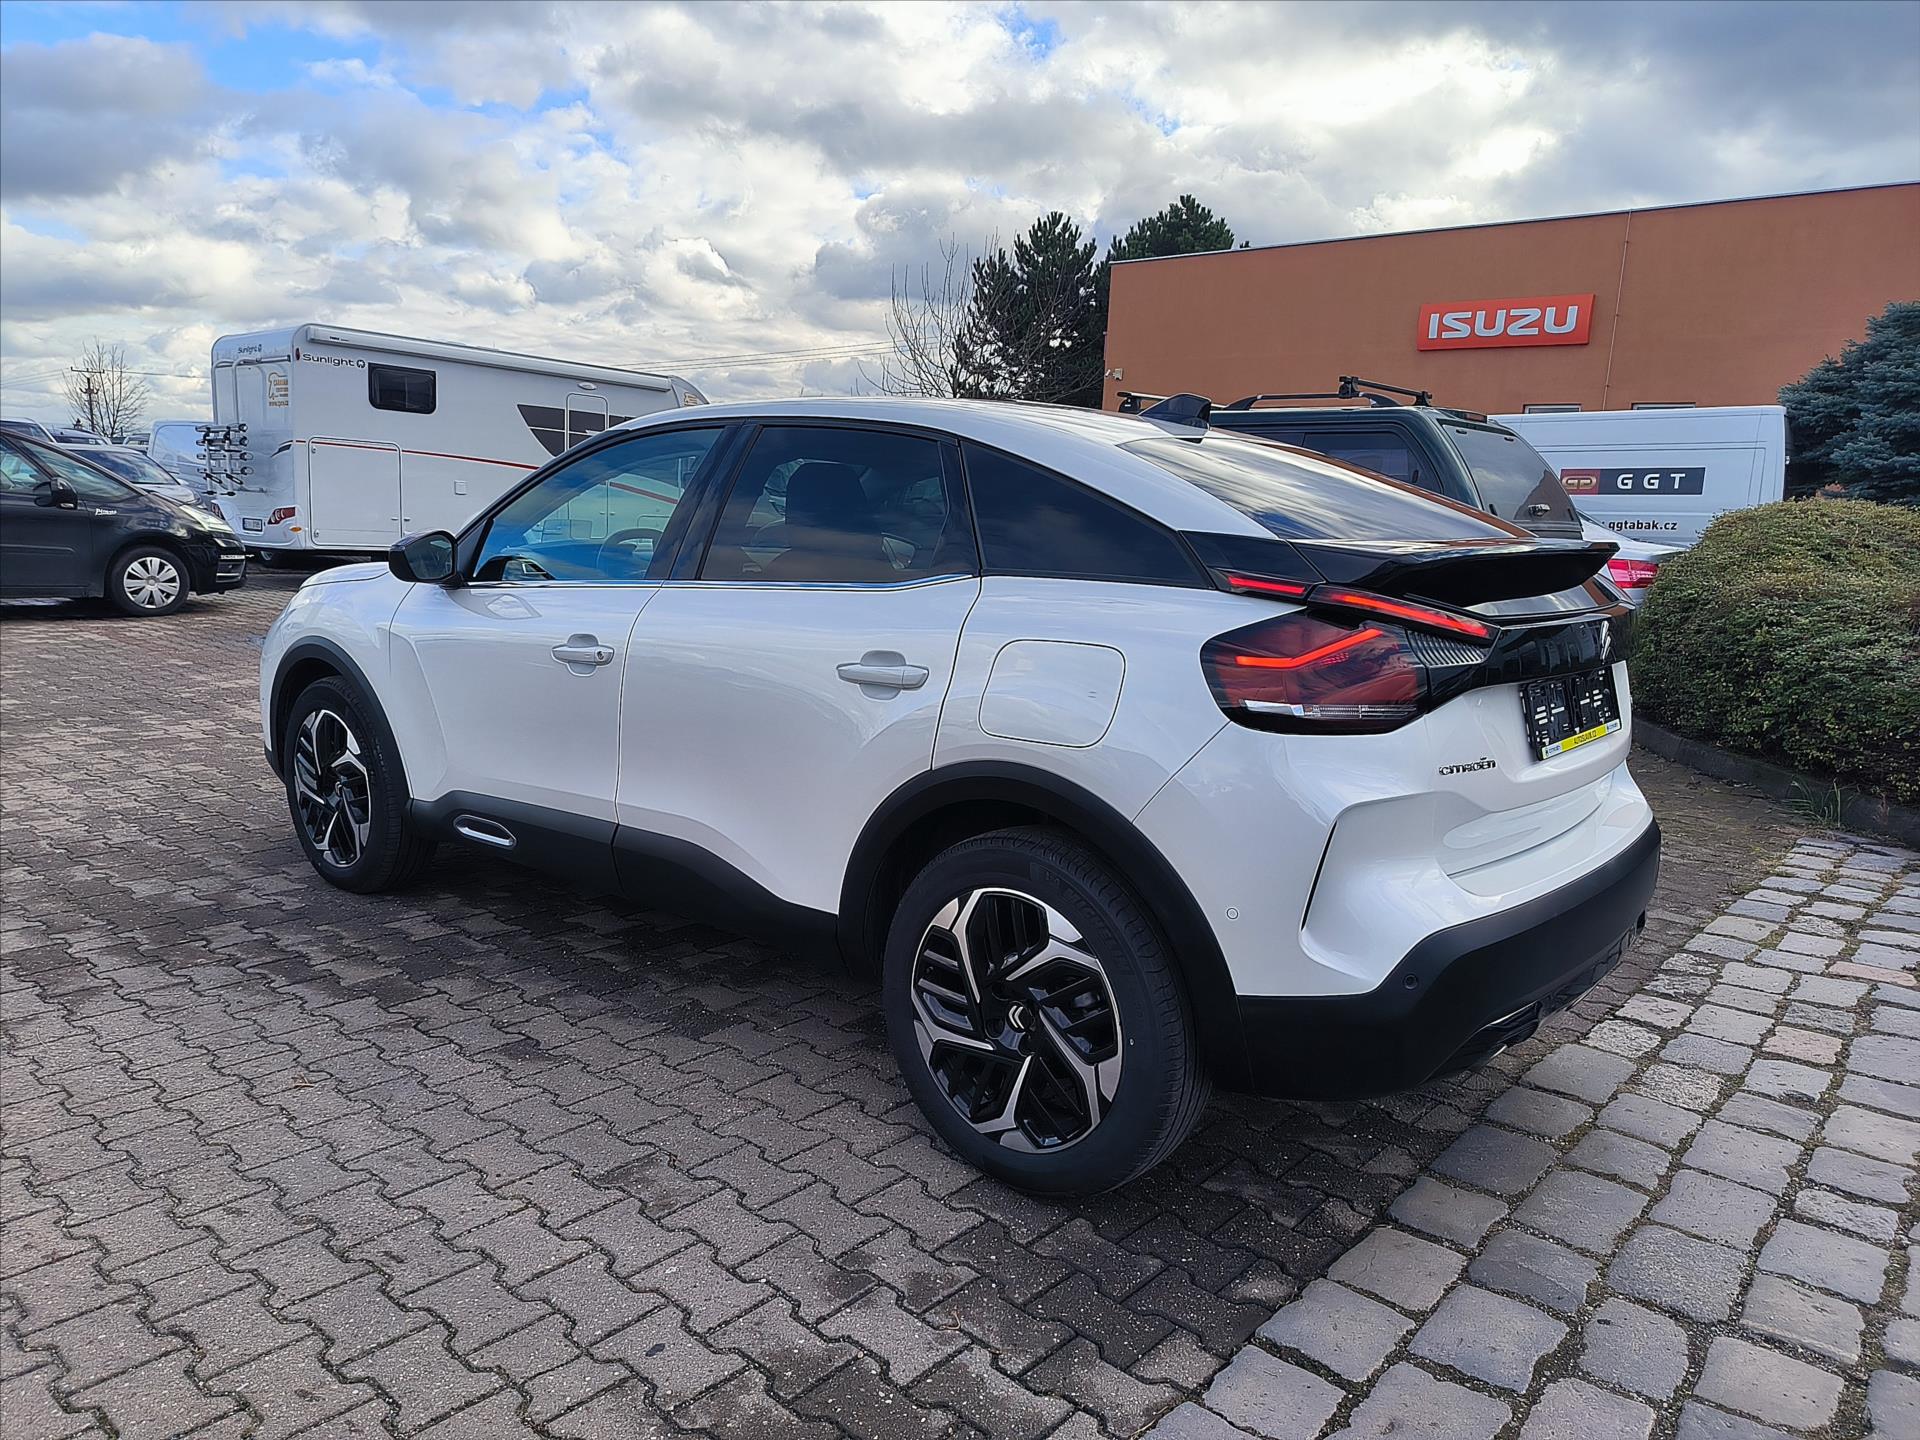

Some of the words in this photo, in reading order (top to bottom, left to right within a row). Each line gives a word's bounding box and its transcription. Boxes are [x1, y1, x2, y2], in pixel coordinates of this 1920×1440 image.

[1428, 305, 1579, 339] ISUZU
[302, 353, 355, 367] Sunlight
[1602, 520, 1678, 532] ggtabak.cz
